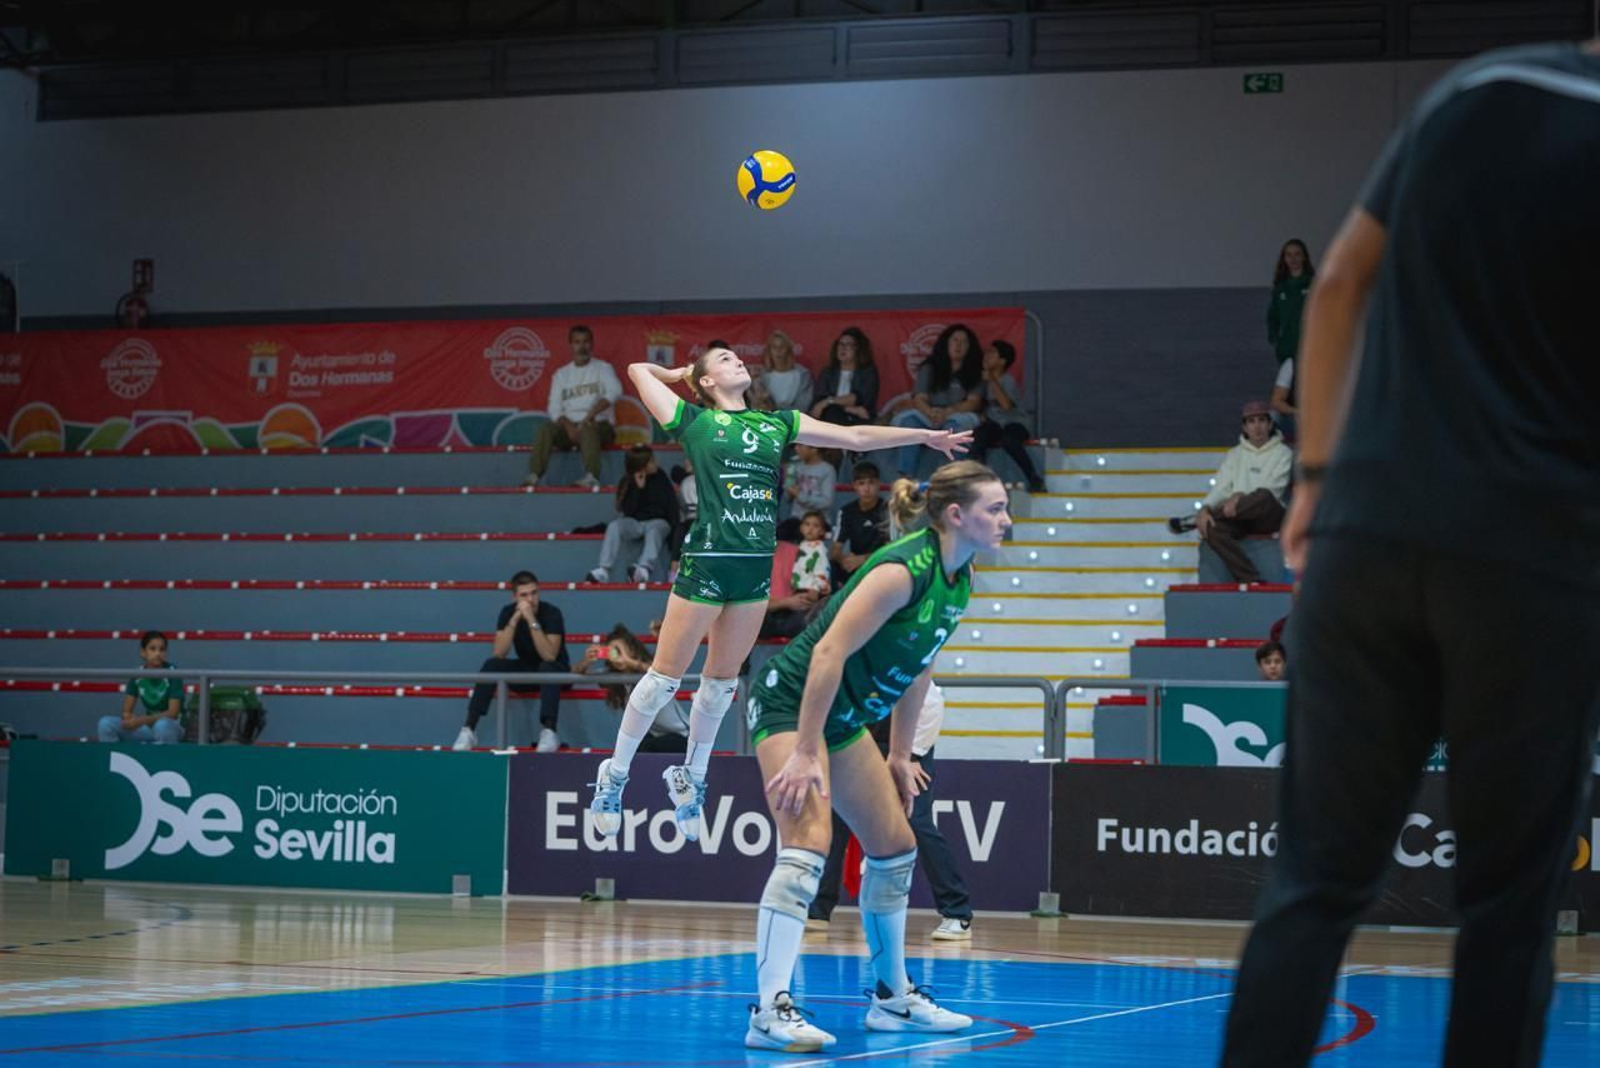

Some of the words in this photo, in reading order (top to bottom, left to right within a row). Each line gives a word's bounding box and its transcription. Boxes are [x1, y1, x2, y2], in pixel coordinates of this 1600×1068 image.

[289, 371, 319, 386] Dos
[320, 369, 394, 386] Hermanas
[742, 427, 759, 453] 9
[256, 785, 397, 817] Diputación
[254, 818, 396, 864] Sevilla
[545, 791, 781, 857] EuroVo
[1097, 818, 1279, 857] Fundació
